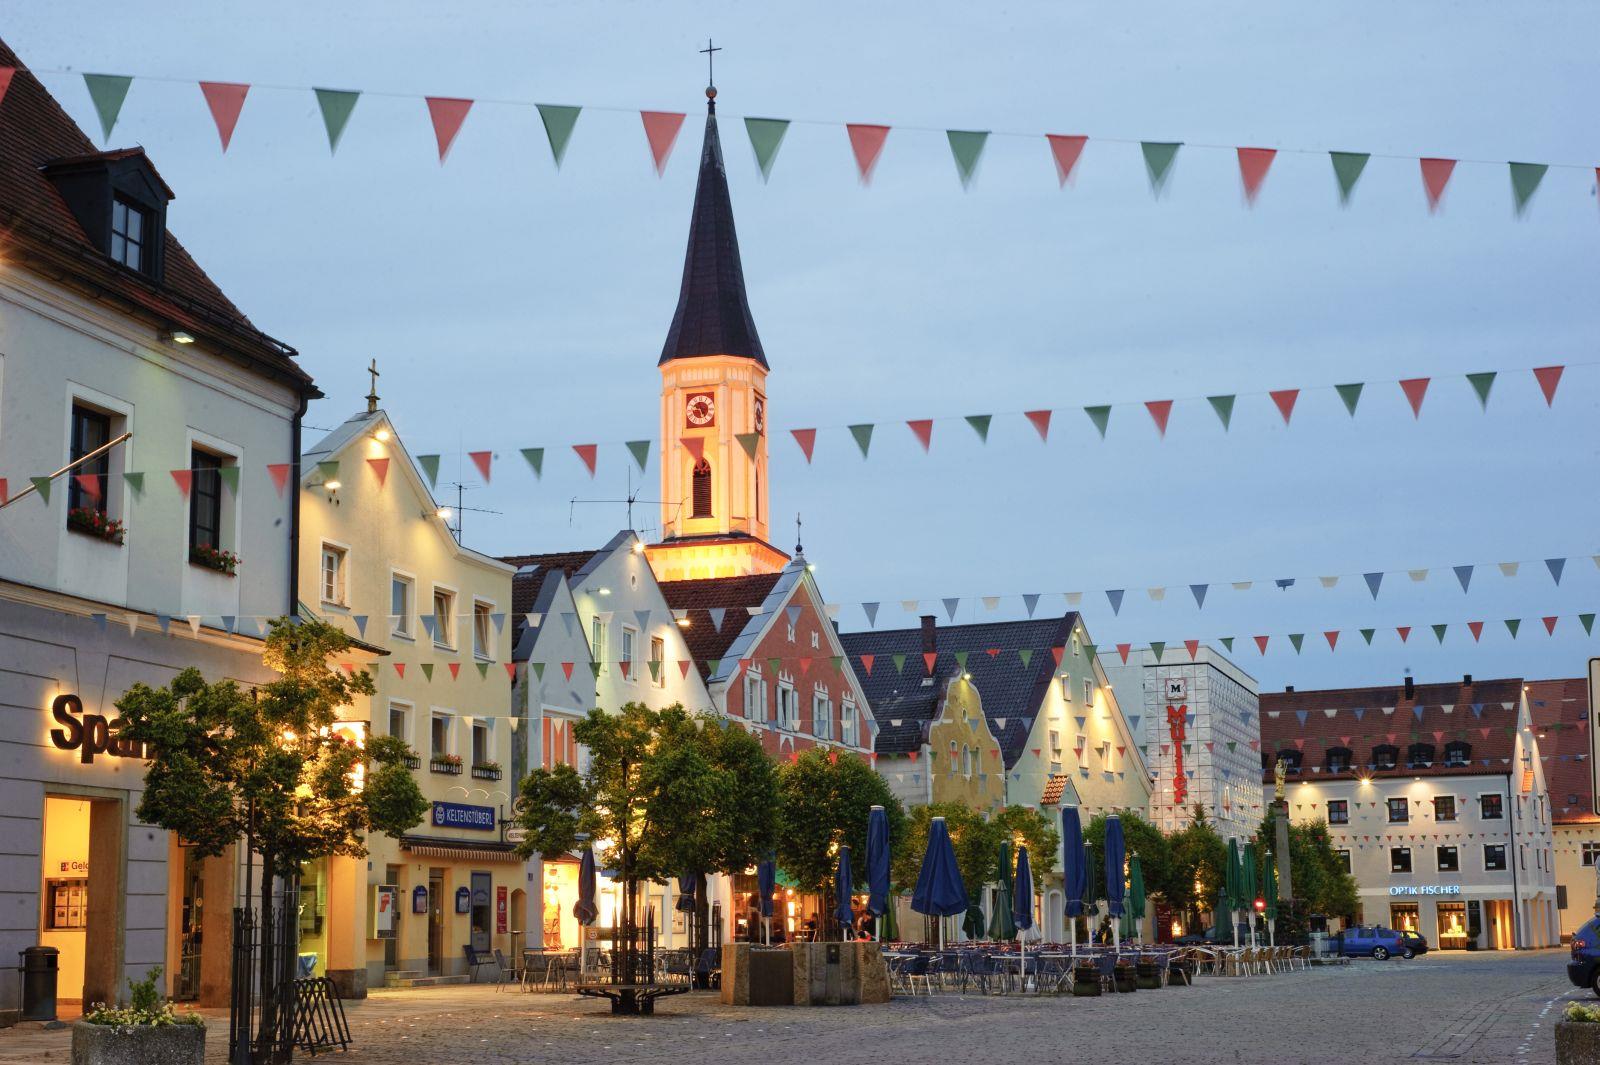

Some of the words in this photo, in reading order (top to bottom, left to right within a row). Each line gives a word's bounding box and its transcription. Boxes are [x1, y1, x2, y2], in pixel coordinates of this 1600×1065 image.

[1171, 684, 1181, 693] M
[446, 808, 493, 825] KELTENSTÜBERL
[1389, 885, 1418, 896] OPTIK
[1421, 884, 1460, 895] FISCHER
